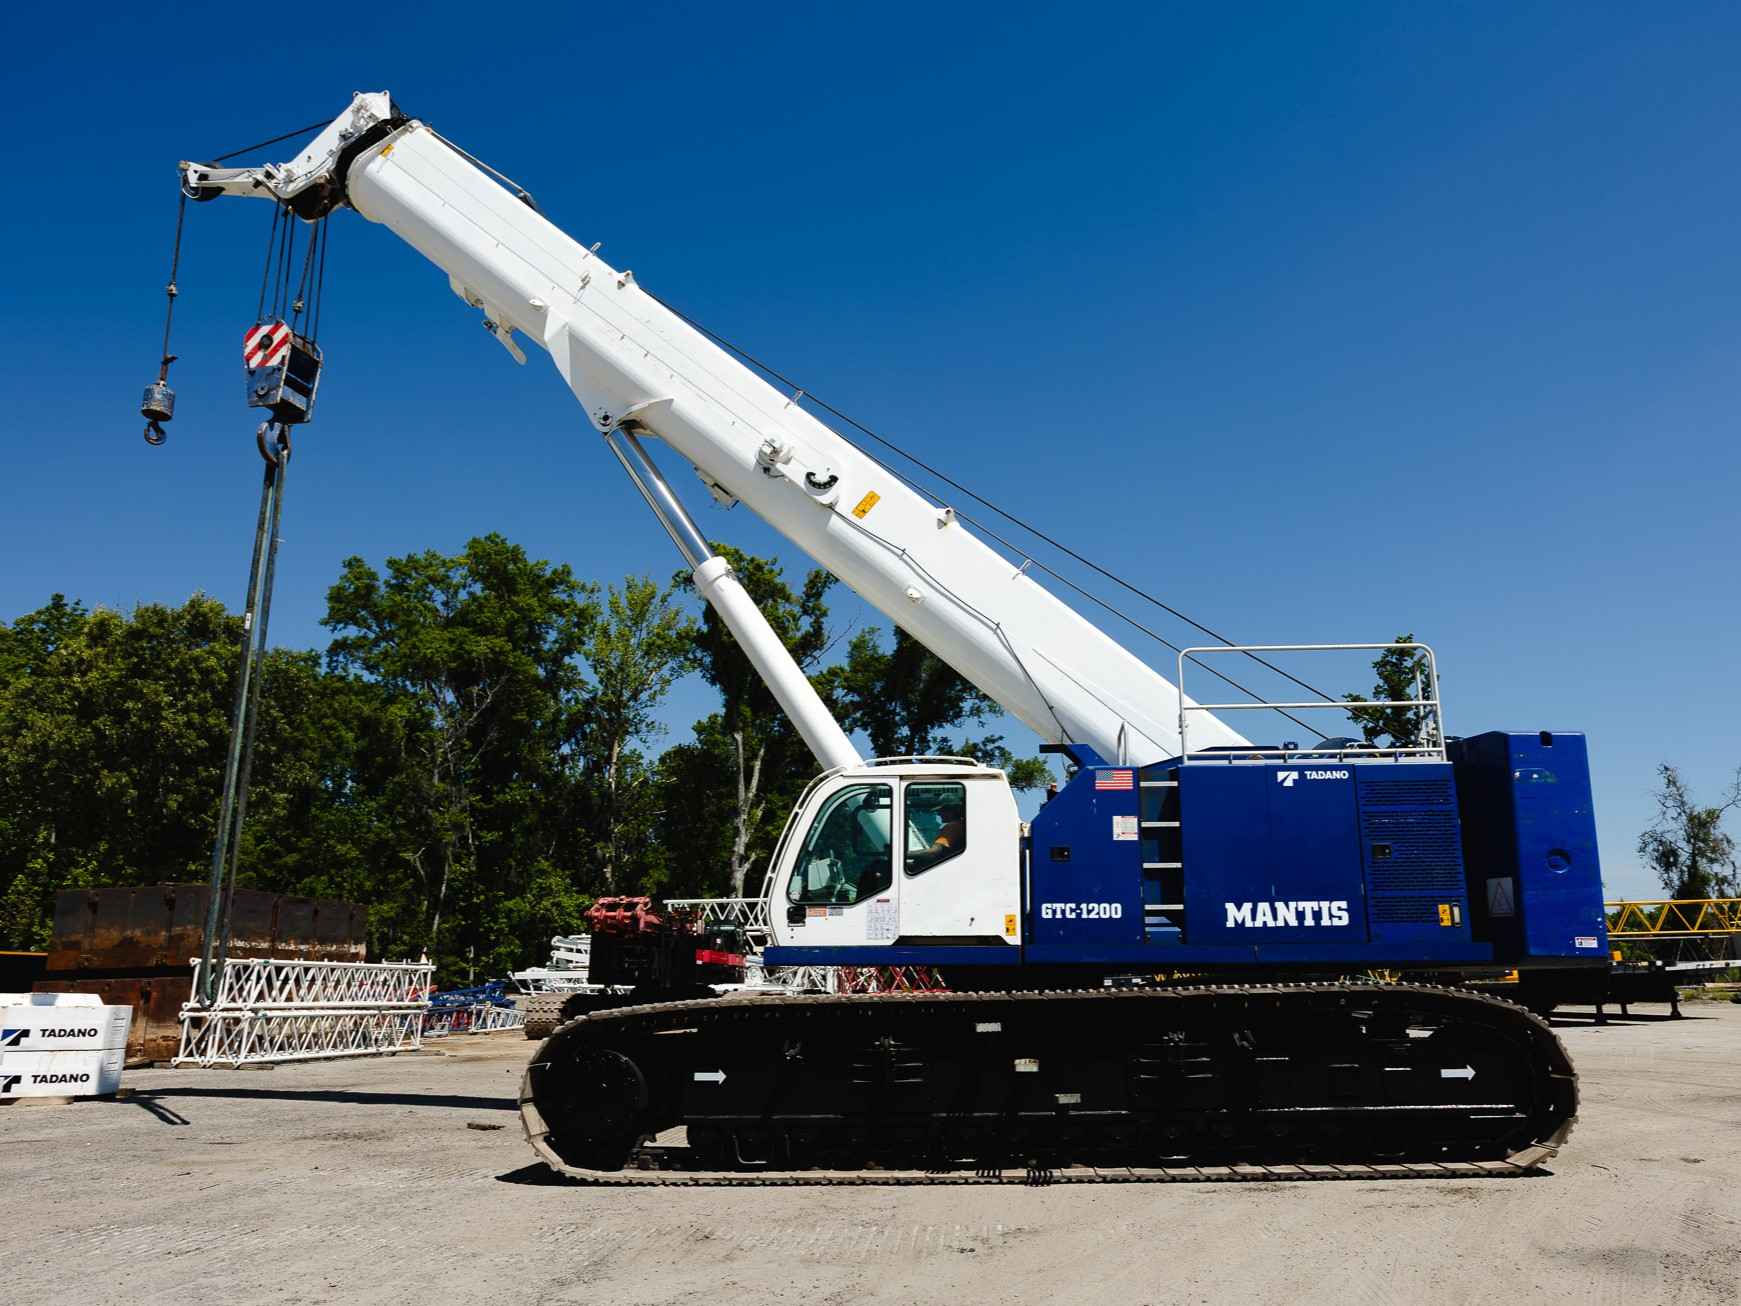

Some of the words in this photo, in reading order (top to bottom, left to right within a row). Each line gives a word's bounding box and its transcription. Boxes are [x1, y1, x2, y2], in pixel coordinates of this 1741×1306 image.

[1304, 770, 1349, 780] TADANO
[1041, 903, 1122, 919] GTC-1200
[1225, 900, 1350, 928] MANTIS
[40, 1028, 98, 1038] TADANO
[31, 1073, 90, 1084] TADANO
